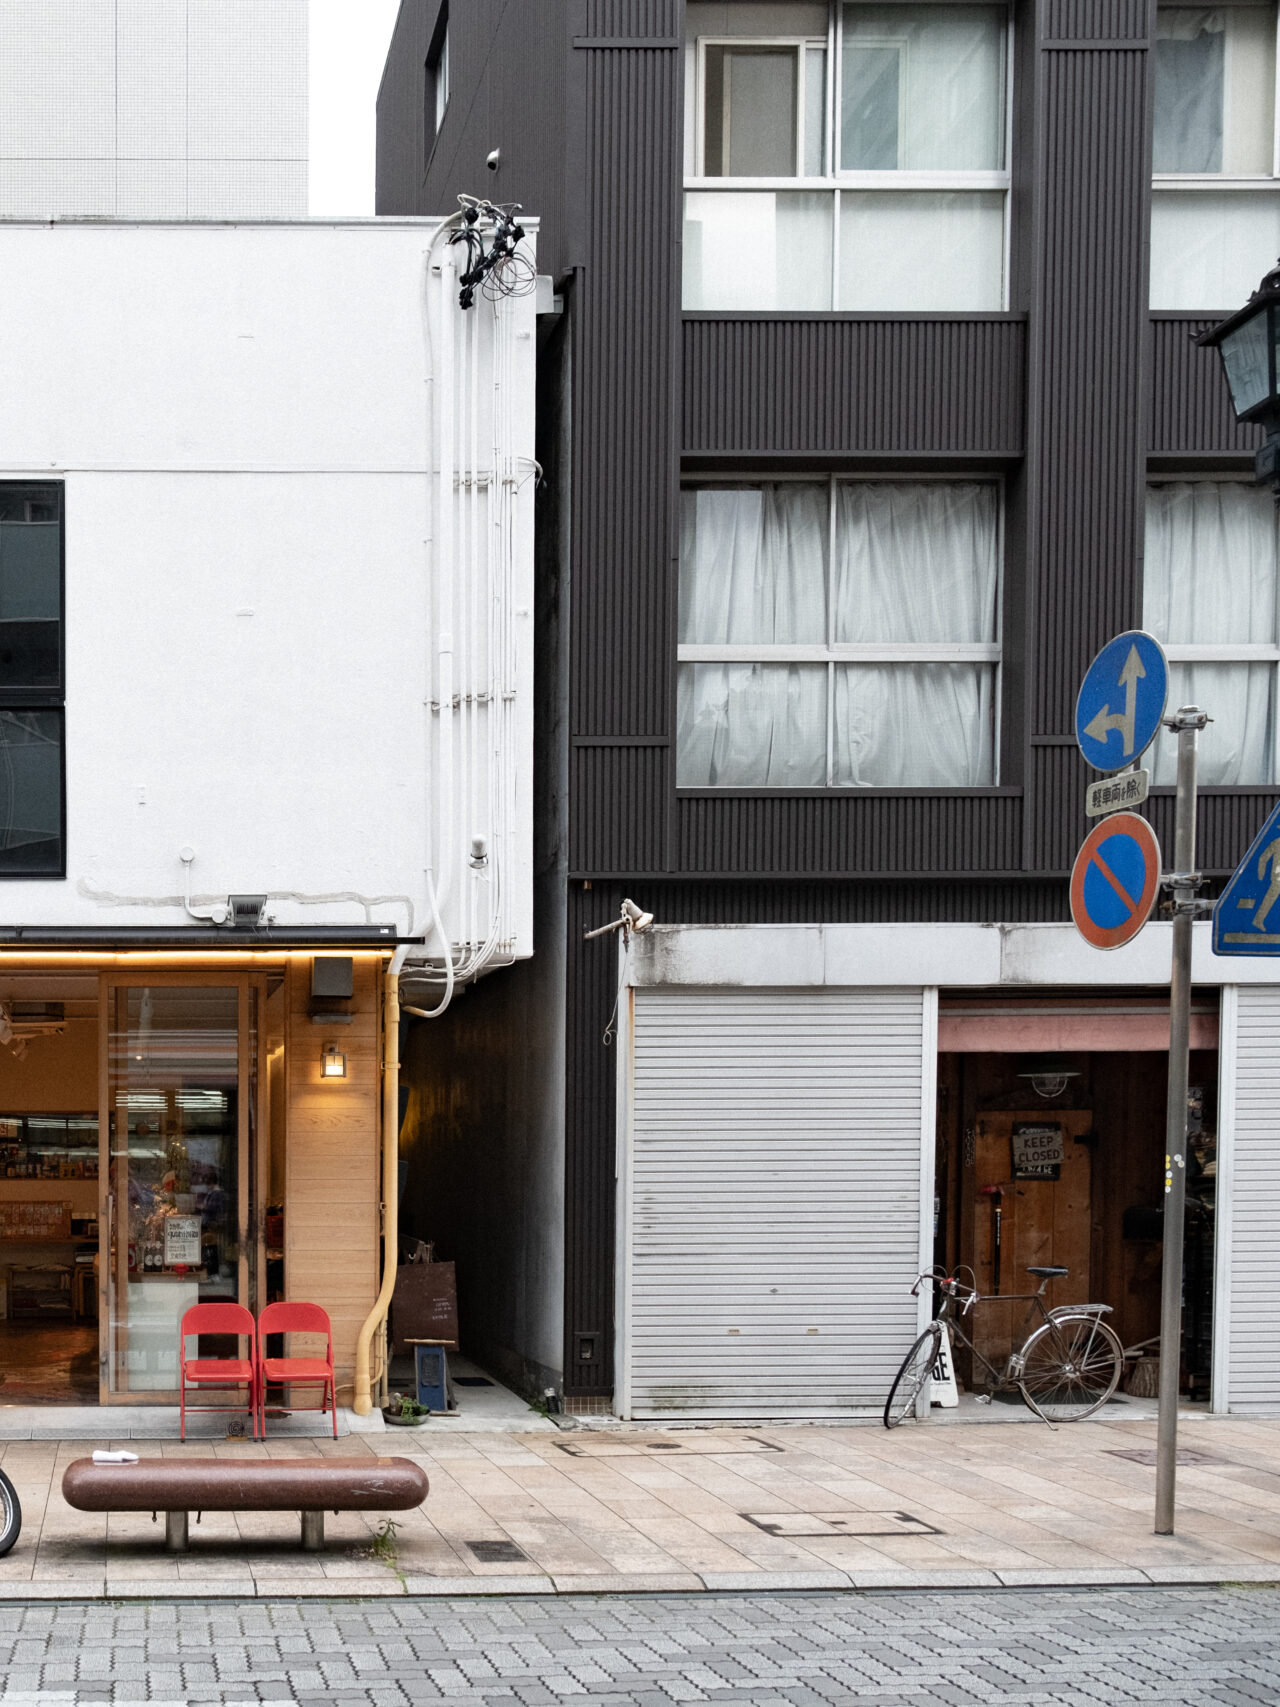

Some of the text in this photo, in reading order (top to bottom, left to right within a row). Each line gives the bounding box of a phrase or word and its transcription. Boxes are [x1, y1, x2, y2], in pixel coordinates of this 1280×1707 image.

[1091, 779, 1141, 808] 軽車両を除く
[1023, 1136, 1054, 1149] KEEP
[1018, 1149, 1060, 1163] CLOSED
